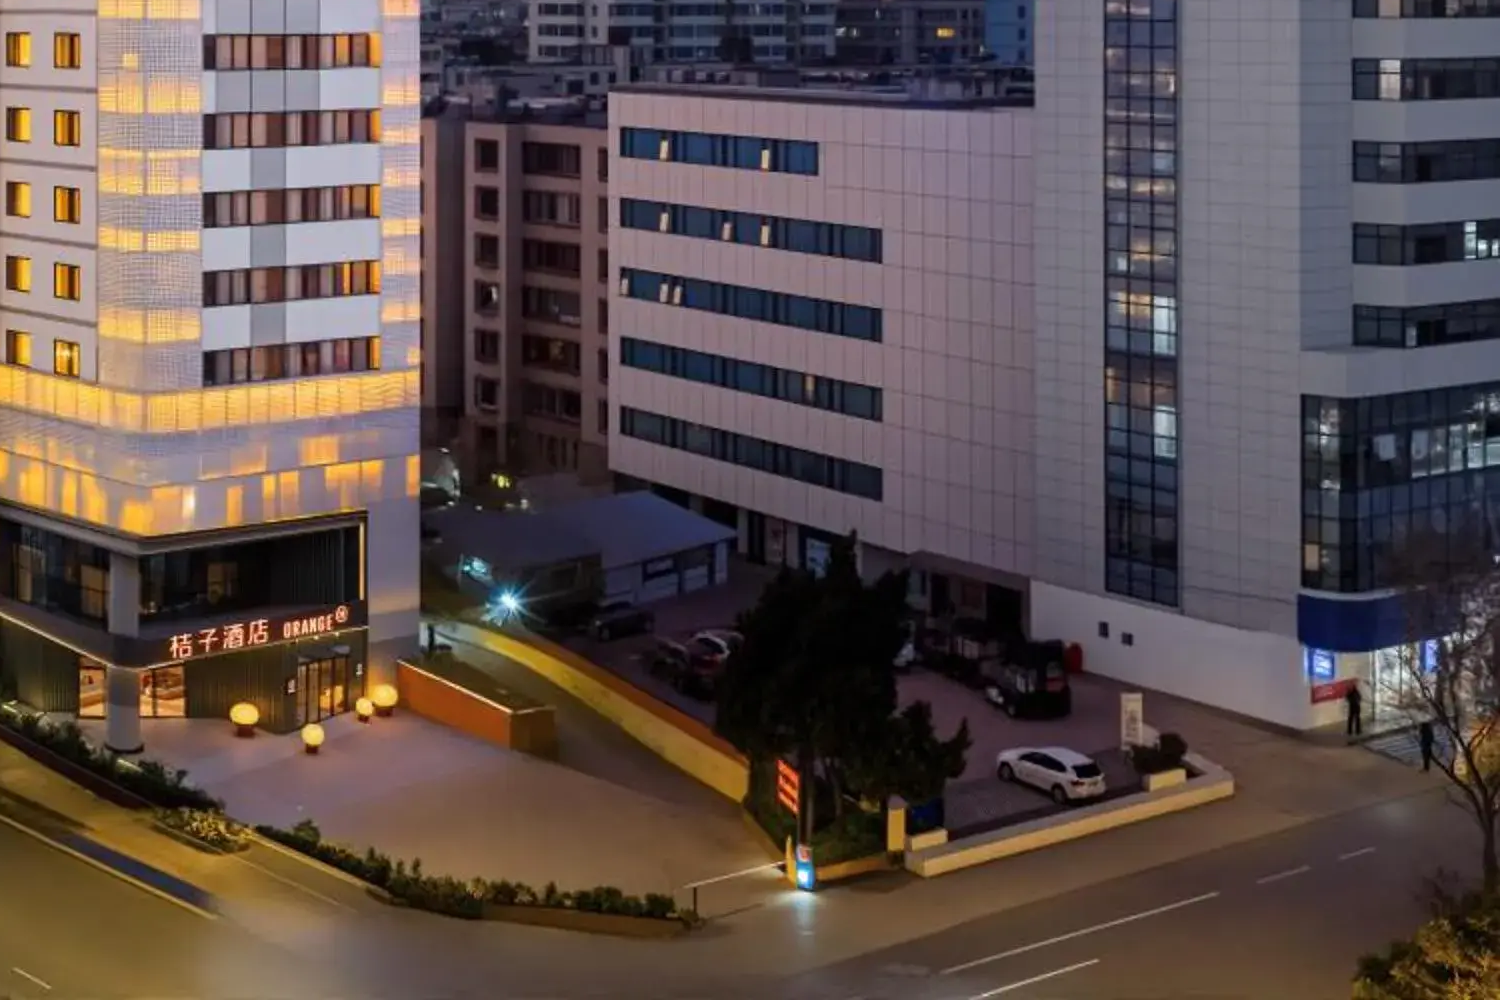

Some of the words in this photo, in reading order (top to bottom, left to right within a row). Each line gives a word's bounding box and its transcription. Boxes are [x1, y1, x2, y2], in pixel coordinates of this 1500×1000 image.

[169, 618, 269, 659] 桔子酒店
[283, 613, 334, 639] ORANGE
